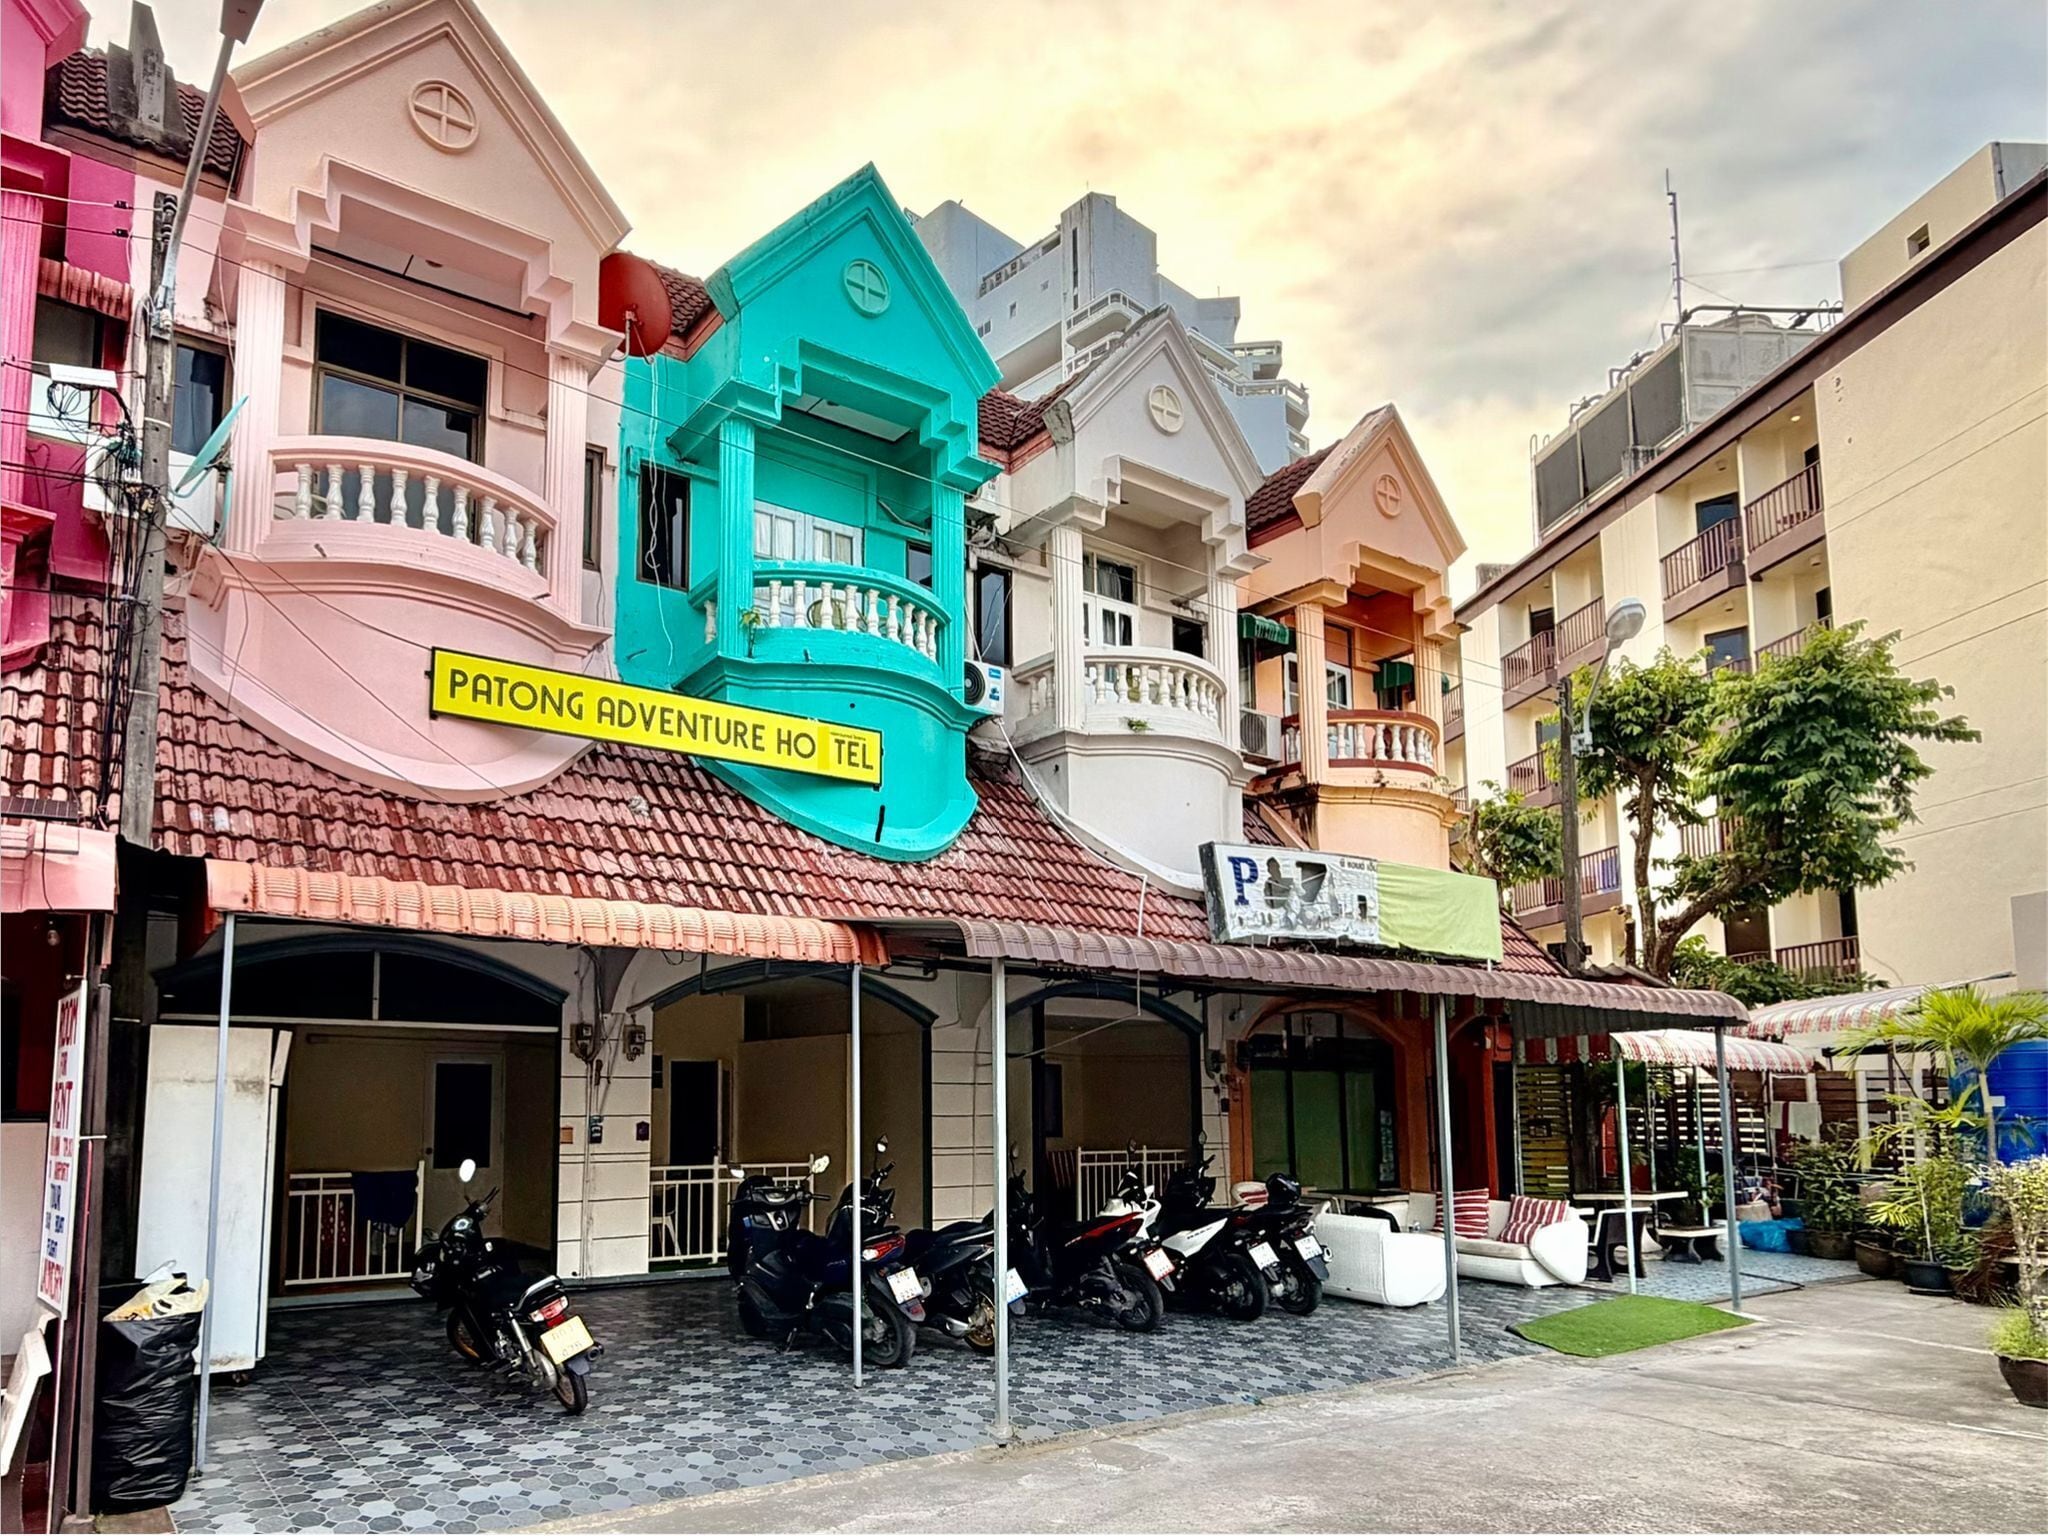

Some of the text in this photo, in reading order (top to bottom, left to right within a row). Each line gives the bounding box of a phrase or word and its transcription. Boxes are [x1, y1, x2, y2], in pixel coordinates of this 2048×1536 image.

[450, 668, 583, 721] PATONG
[597, 696, 765, 752] ADVENTURE
[53, 1081, 73, 1129] RENT
